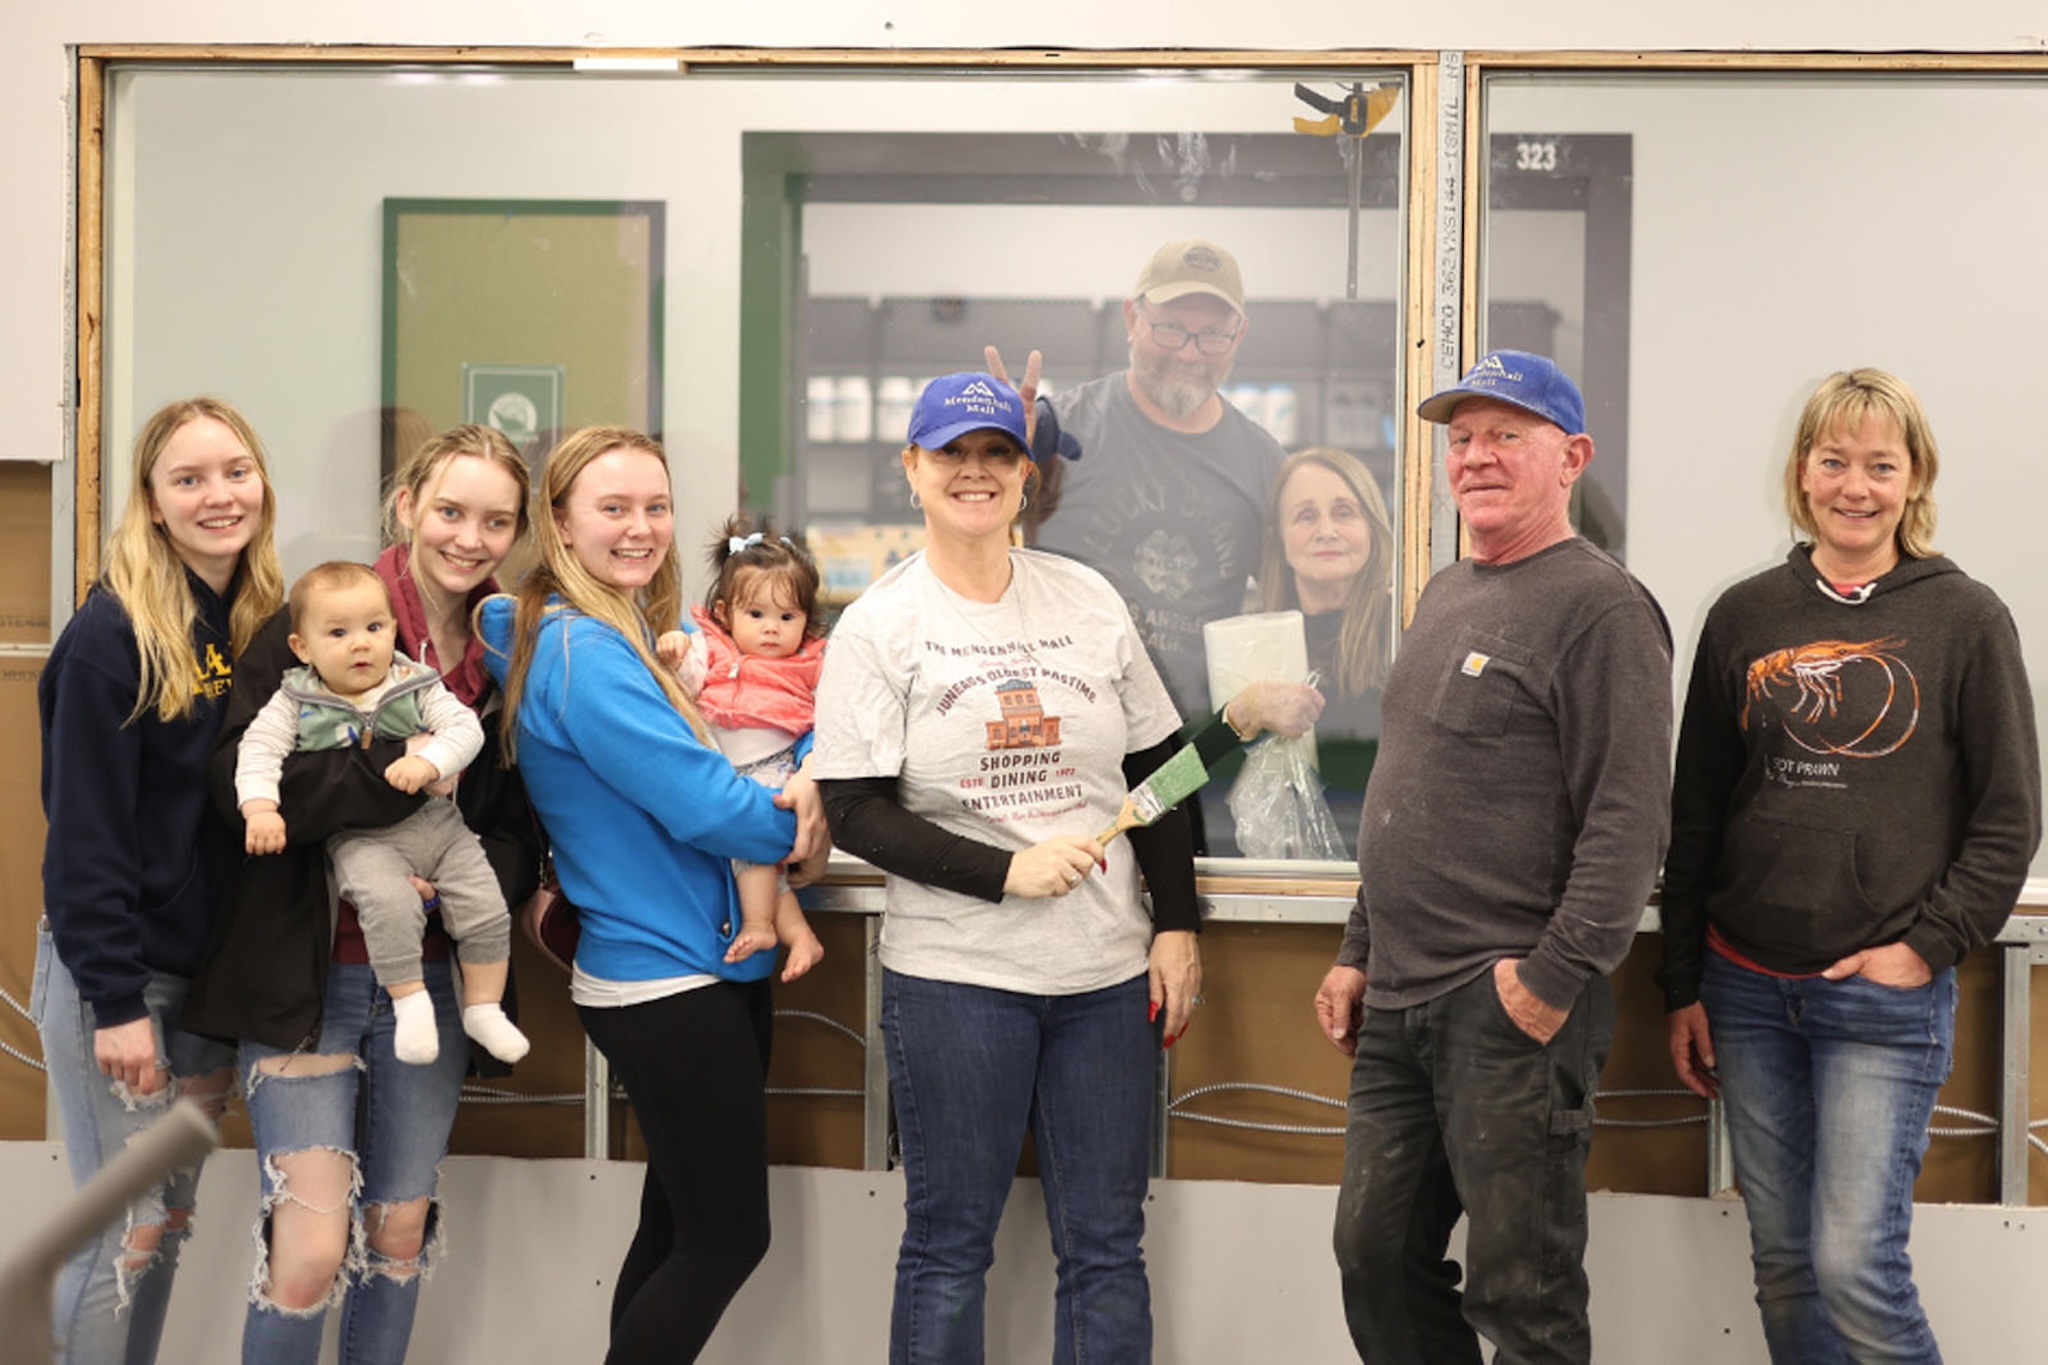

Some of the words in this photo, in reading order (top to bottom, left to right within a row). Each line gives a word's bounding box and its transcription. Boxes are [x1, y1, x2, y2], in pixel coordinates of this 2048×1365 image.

[1516, 143, 1557, 171] 323
[1440, 304, 1457, 370] CEMCO
[966, 404, 995, 416] Mall
[1038, 634, 1074, 652] MALL
[979, 751, 1062, 772] SHOPPING
[990, 769, 1048, 790] DINING
[962, 784, 1084, 812] ENTERTAINMENT
